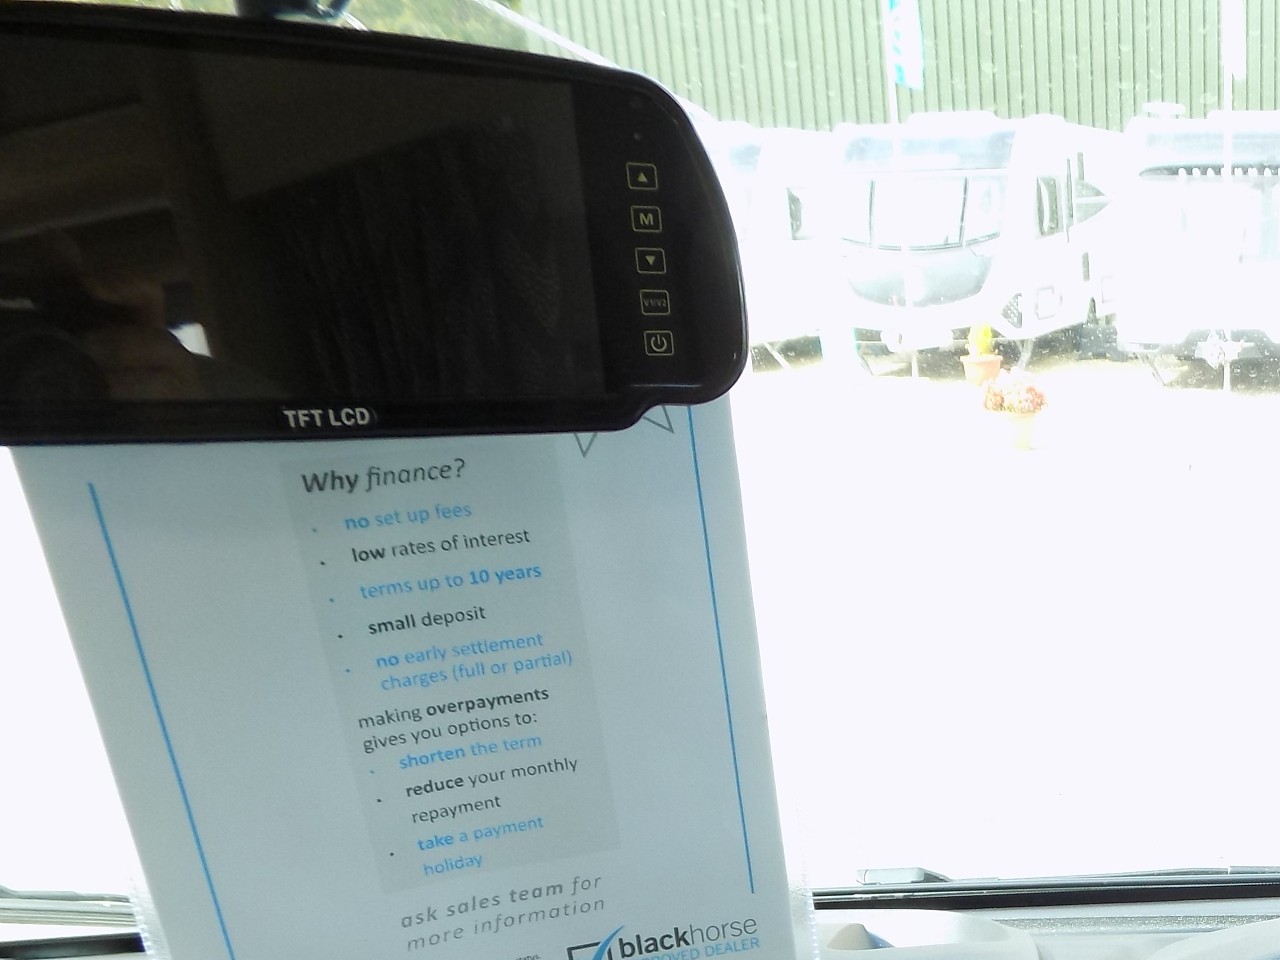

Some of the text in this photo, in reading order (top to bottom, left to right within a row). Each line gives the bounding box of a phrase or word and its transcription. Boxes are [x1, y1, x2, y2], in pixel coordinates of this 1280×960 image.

[639, 213, 653, 225] M
[284, 407, 371, 428] TFT LCD
[301, 458, 466, 494] Why finance?
[344, 503, 472, 531] no set up fees
[352, 529, 530, 563] low rates of interest
[360, 564, 543, 600] terms up to 10 years
[368, 606, 486, 635] small deposit
[375, 633, 544, 669] no early settlement
[380, 650, 573, 691] charges (full or partial)
[358, 686, 550, 730] making overpayments
[363, 710, 539, 754] gives you options to:
[399, 735, 543, 770] shorten the term
[405, 757, 578, 798] reduce your monthly
[411, 795, 501, 824] repayment
[417, 816, 544, 851] take a payment
[422, 853, 483, 876] holiday
[401, 875, 602, 929] ask sales team for
[407, 898, 605, 952] more information
[618, 917, 757, 959] blackhorse
[704, 937, 760, 958] DEALER
